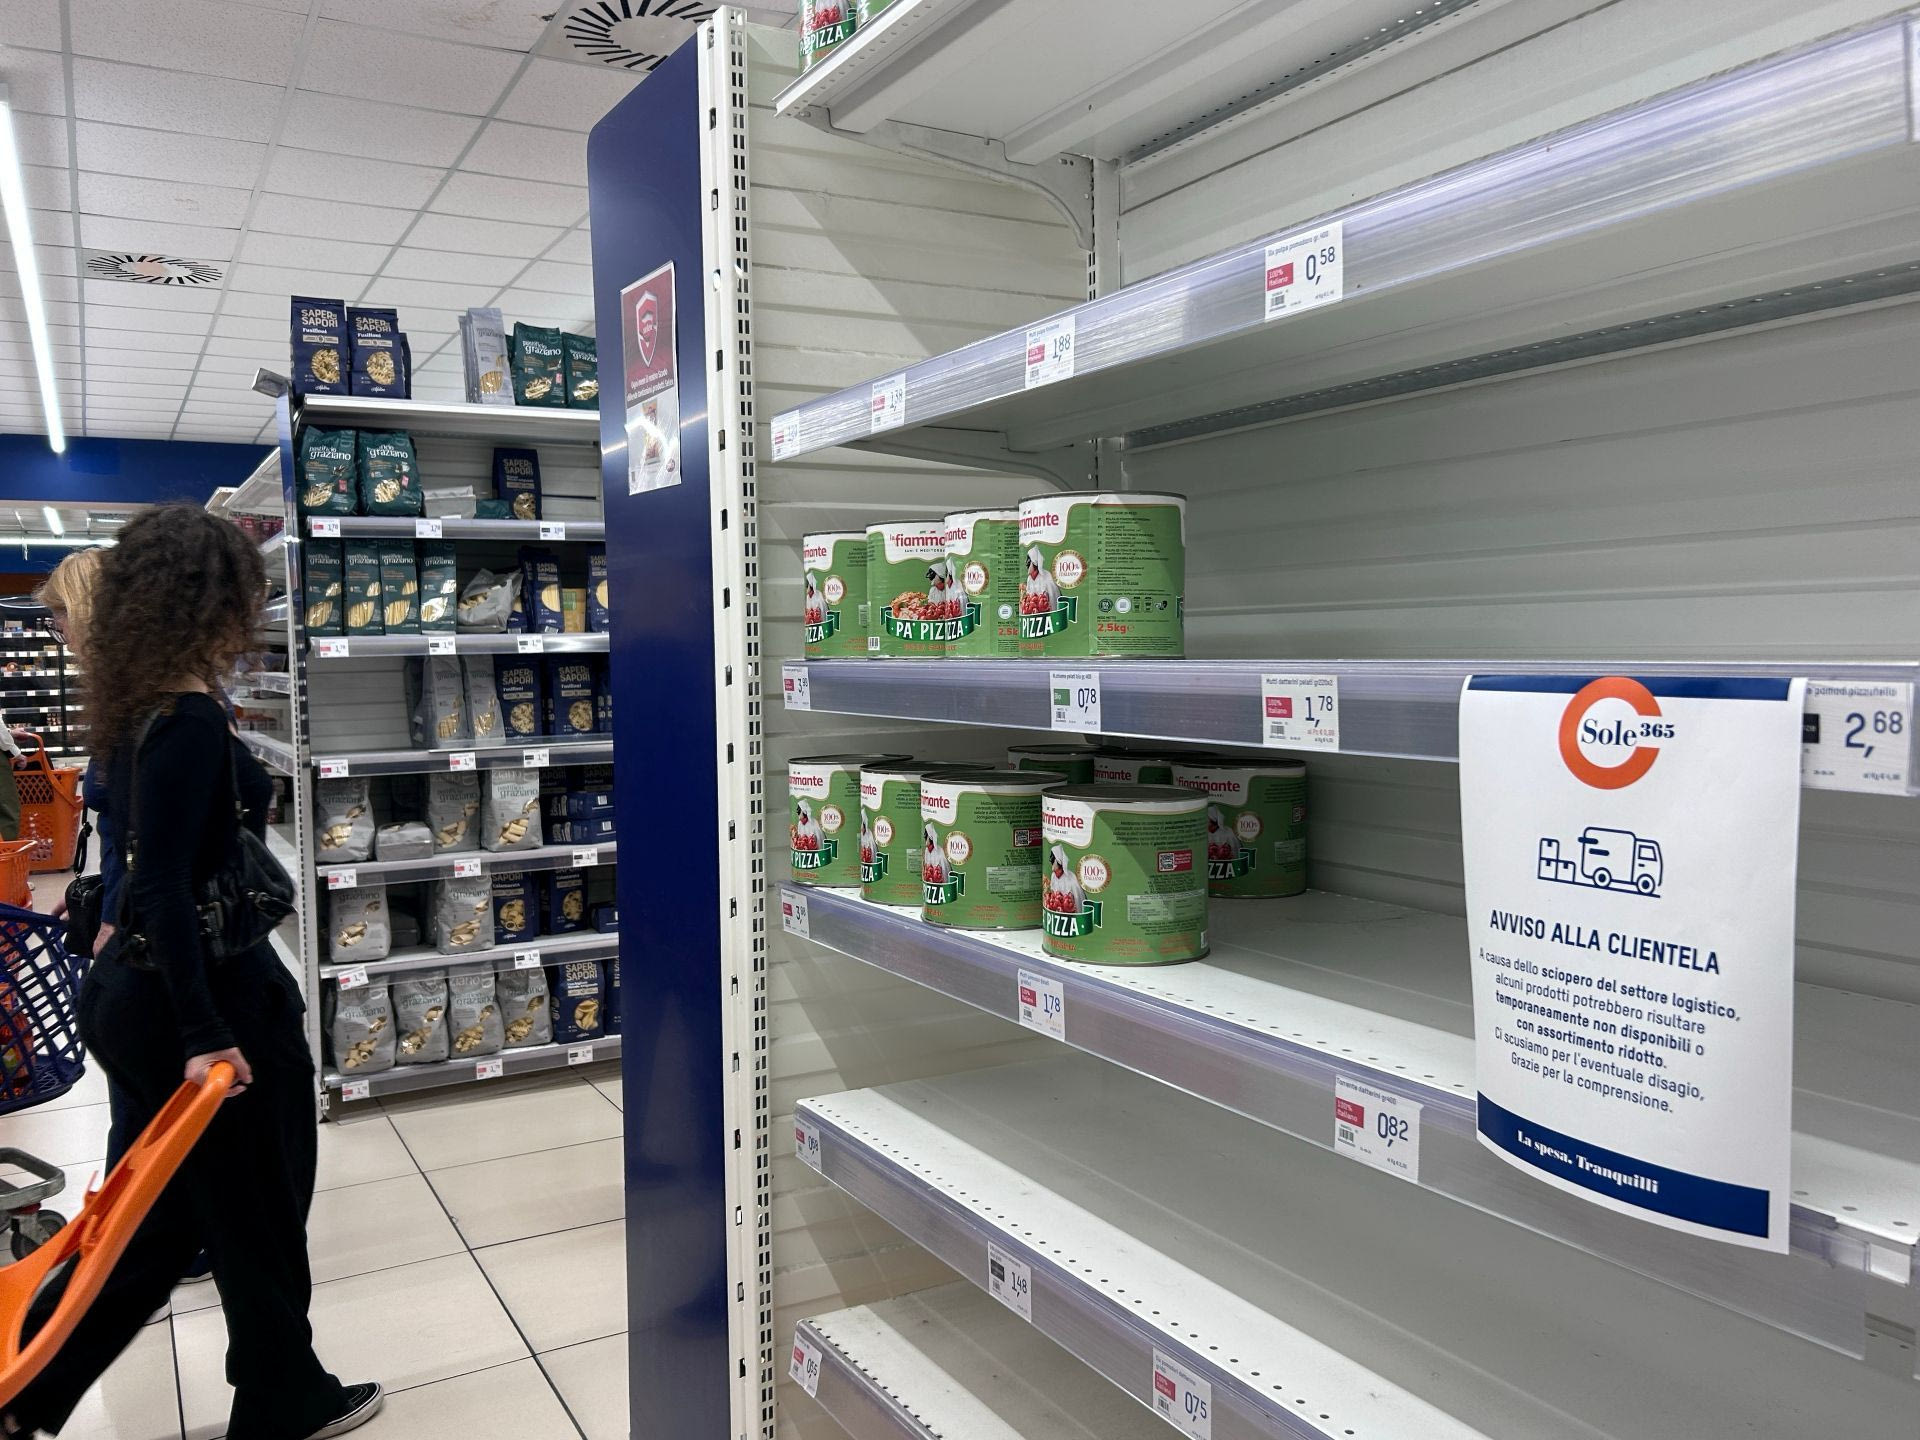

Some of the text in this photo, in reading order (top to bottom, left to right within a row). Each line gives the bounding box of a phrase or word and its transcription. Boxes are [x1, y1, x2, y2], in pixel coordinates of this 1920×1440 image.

[811, 25, 844, 49] PIZZA
[1306, 246, 1335, 285] 0,58
[301, 309, 333, 319] SAPER
[302, 317, 338, 328] SAPORI
[356, 317, 386, 327] SAPER
[356, 323, 391, 332] SAPORI
[525, 345, 561, 355] graziano
[1053, 334, 1070, 361] 1,88
[309, 451, 351, 460] graziano
[369, 448, 408, 458] graziano
[503, 458, 529, 468] SAPER
[504, 466, 534, 475] SAPORI
[384, 557, 413, 565] graziano
[425, 559, 454, 567] graziano
[1059, 562, 1079, 572] 100%
[896, 621, 915, 638] PA'
[1022, 616, 1054, 638] PIZZA
[1097, 623, 1126, 634] 2,5kg
[502, 669, 530, 678] SAPER
[559, 666, 585, 674] SAPER
[502, 676, 534, 685] SAPORI
[560, 673, 590, 682] SAPORI
[1078, 688, 1096, 714] 0,78
[1305, 695, 1333, 728] 1,78
[1581, 718, 1675, 747] Sole 365
[1845, 710, 1903, 758] 2,68
[500, 788, 538, 799] graziano
[950, 841, 967, 850] 100%
[795, 852, 821, 868] PIZZA
[1083, 866, 1104, 876] 100%
[1046, 916, 1080, 936] PIZZA
[1490, 910, 1720, 975] AVVISO ALLA CLIENTELA
[565, 962, 593, 971] SAPER
[566, 971, 597, 981] SAPORI
[1479, 947, 1741, 1022] A causa dello sciopero del settore logistico,
[1044, 993, 1060, 1019] 1,78
[1495, 973, 1705, 1034] alcuni prodotti potrebbero risultare
[1496, 990, 1705, 1056] temporaneamente non disponibili o
[1516, 1018, 1668, 1069] con assortimento ridotto.
[1495, 1026, 1704, 1101] Ci scusiamo per l'eventuale disagio,
[1511, 1051, 1673, 1113] Grazie per la comprensione.
[1337, 1099, 1353, 1112] 100%
[1337, 1109, 1358, 1122] Italiano
[1377, 1112, 1408, 1147] 0,82
[1517, 1130, 1659, 1194] La spesa. Tranquilli
[1012, 1272, 1027, 1298] 1,48
[1185, 1391, 1207, 1423] 0,75
